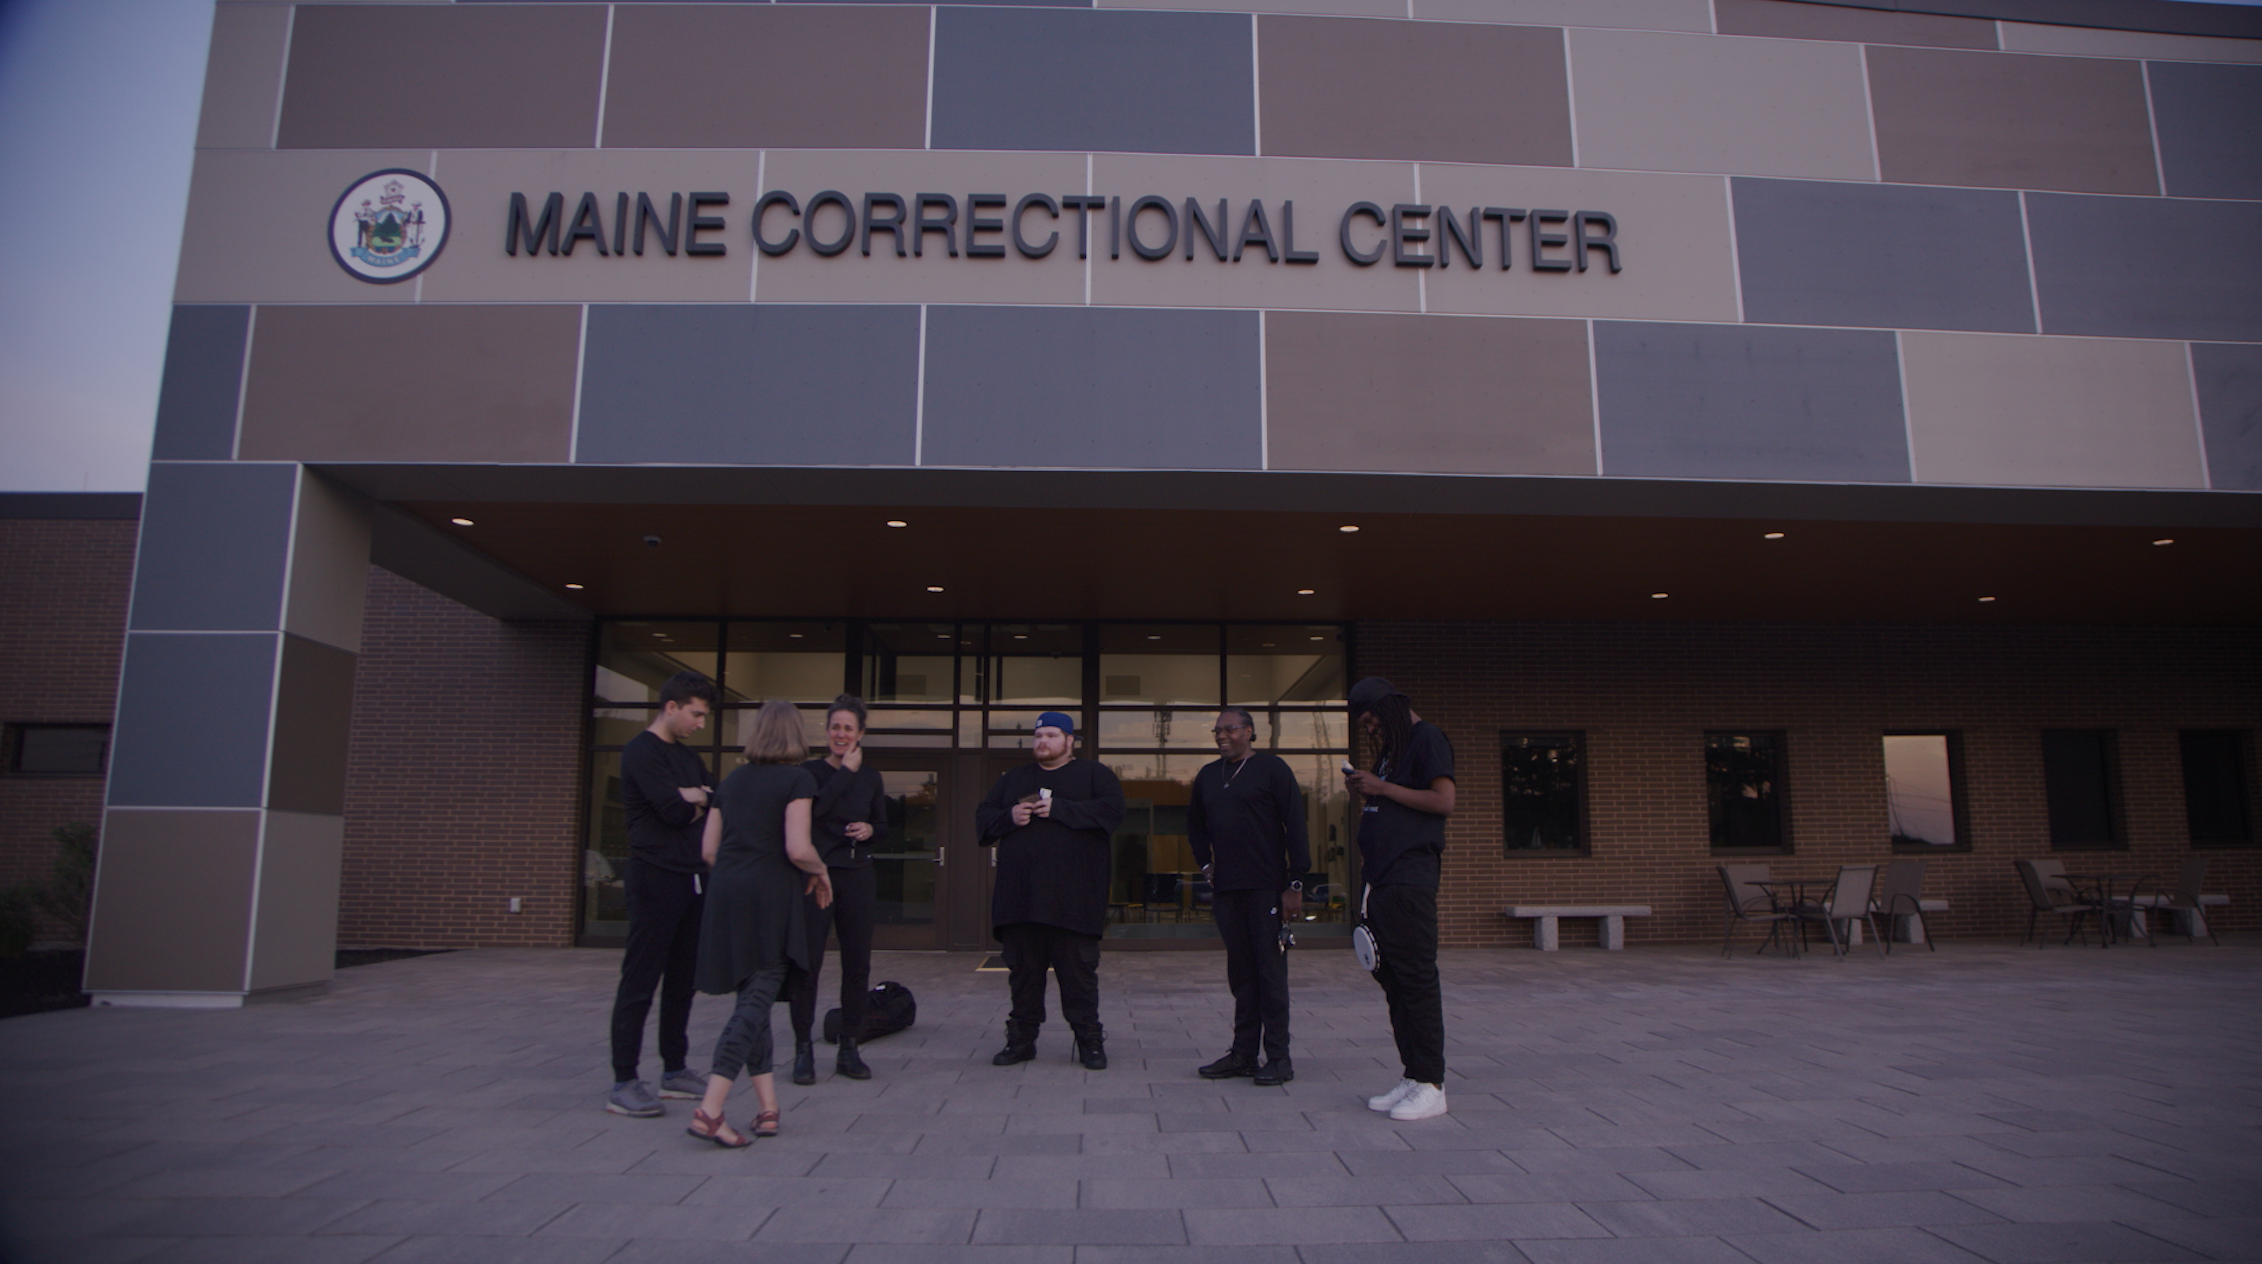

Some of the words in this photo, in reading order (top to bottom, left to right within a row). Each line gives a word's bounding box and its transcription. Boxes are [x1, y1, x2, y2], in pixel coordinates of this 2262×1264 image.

[505, 192, 730, 257] MAINE
[752, 190, 1319, 264] CORRECTIONAL
[1340, 201, 1622, 274] CENTER
[366, 255, 400, 265] MAINE
